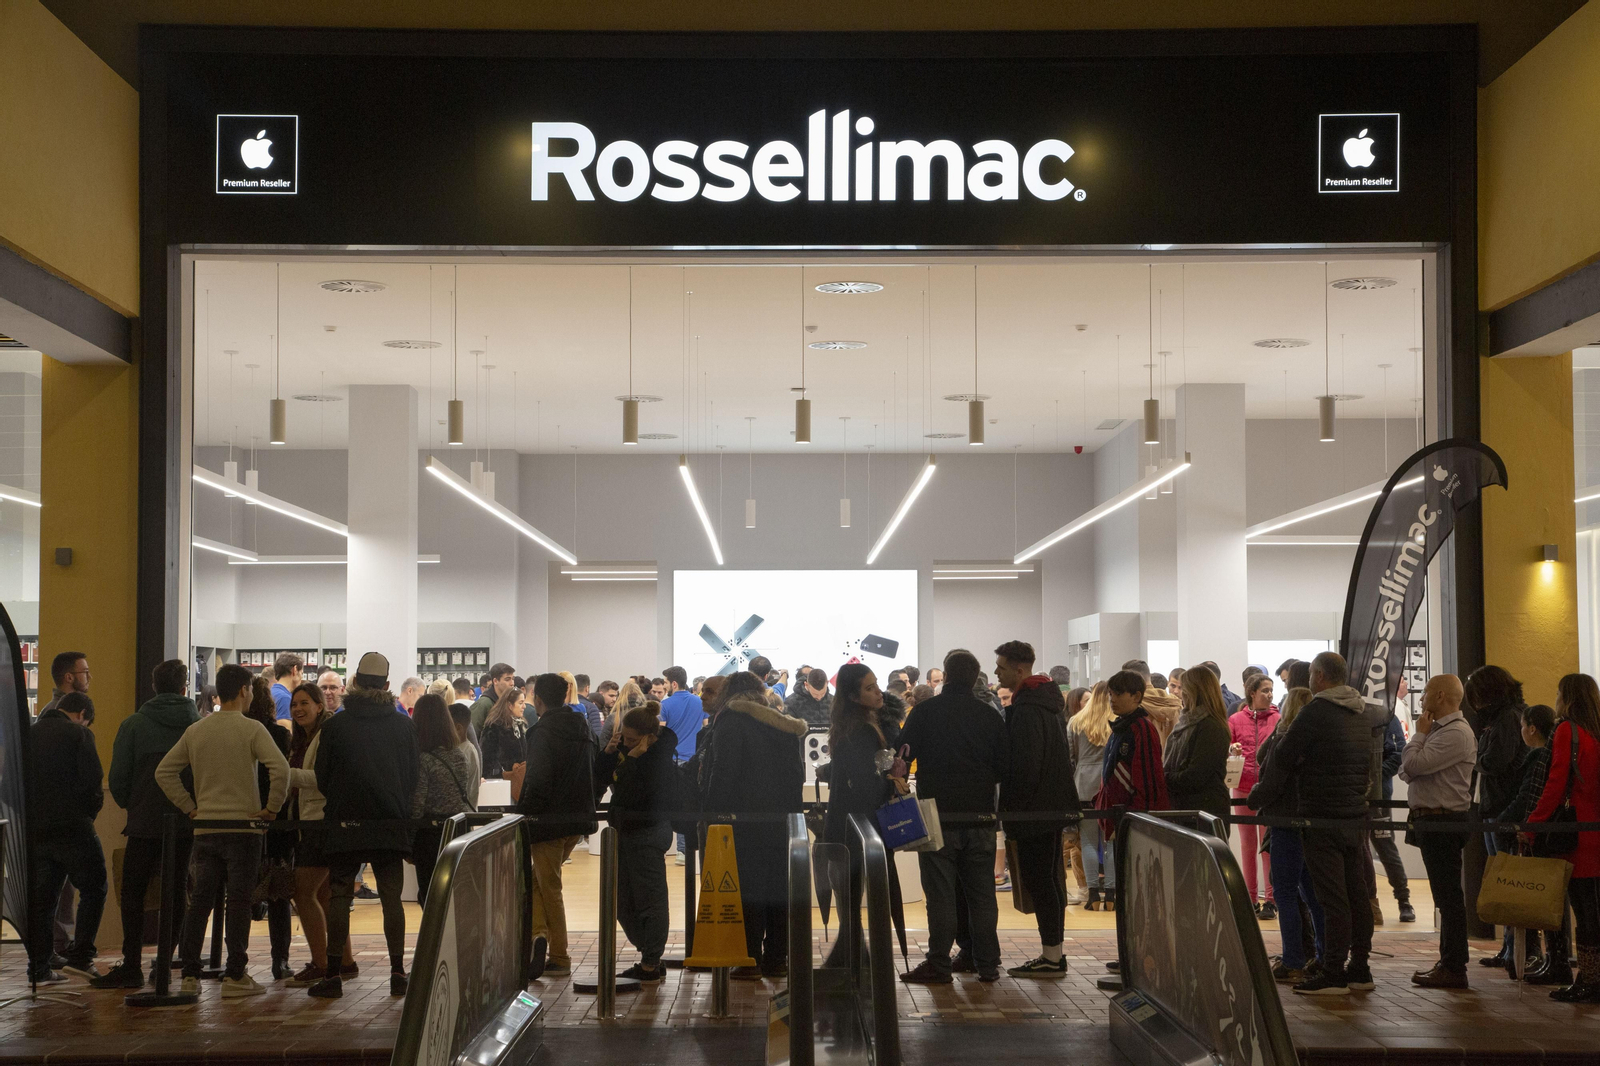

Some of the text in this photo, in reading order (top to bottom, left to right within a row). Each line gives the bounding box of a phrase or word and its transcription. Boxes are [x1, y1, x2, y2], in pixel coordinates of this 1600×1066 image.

[223, 179, 291, 187] Premium Reseller
[1325, 177, 1393, 186] Premium Reseller
[1440, 473, 1458, 495] Premium
[1361, 503, 1437, 706] Rossellimac
[1496, 876, 1546, 892] MANGO
